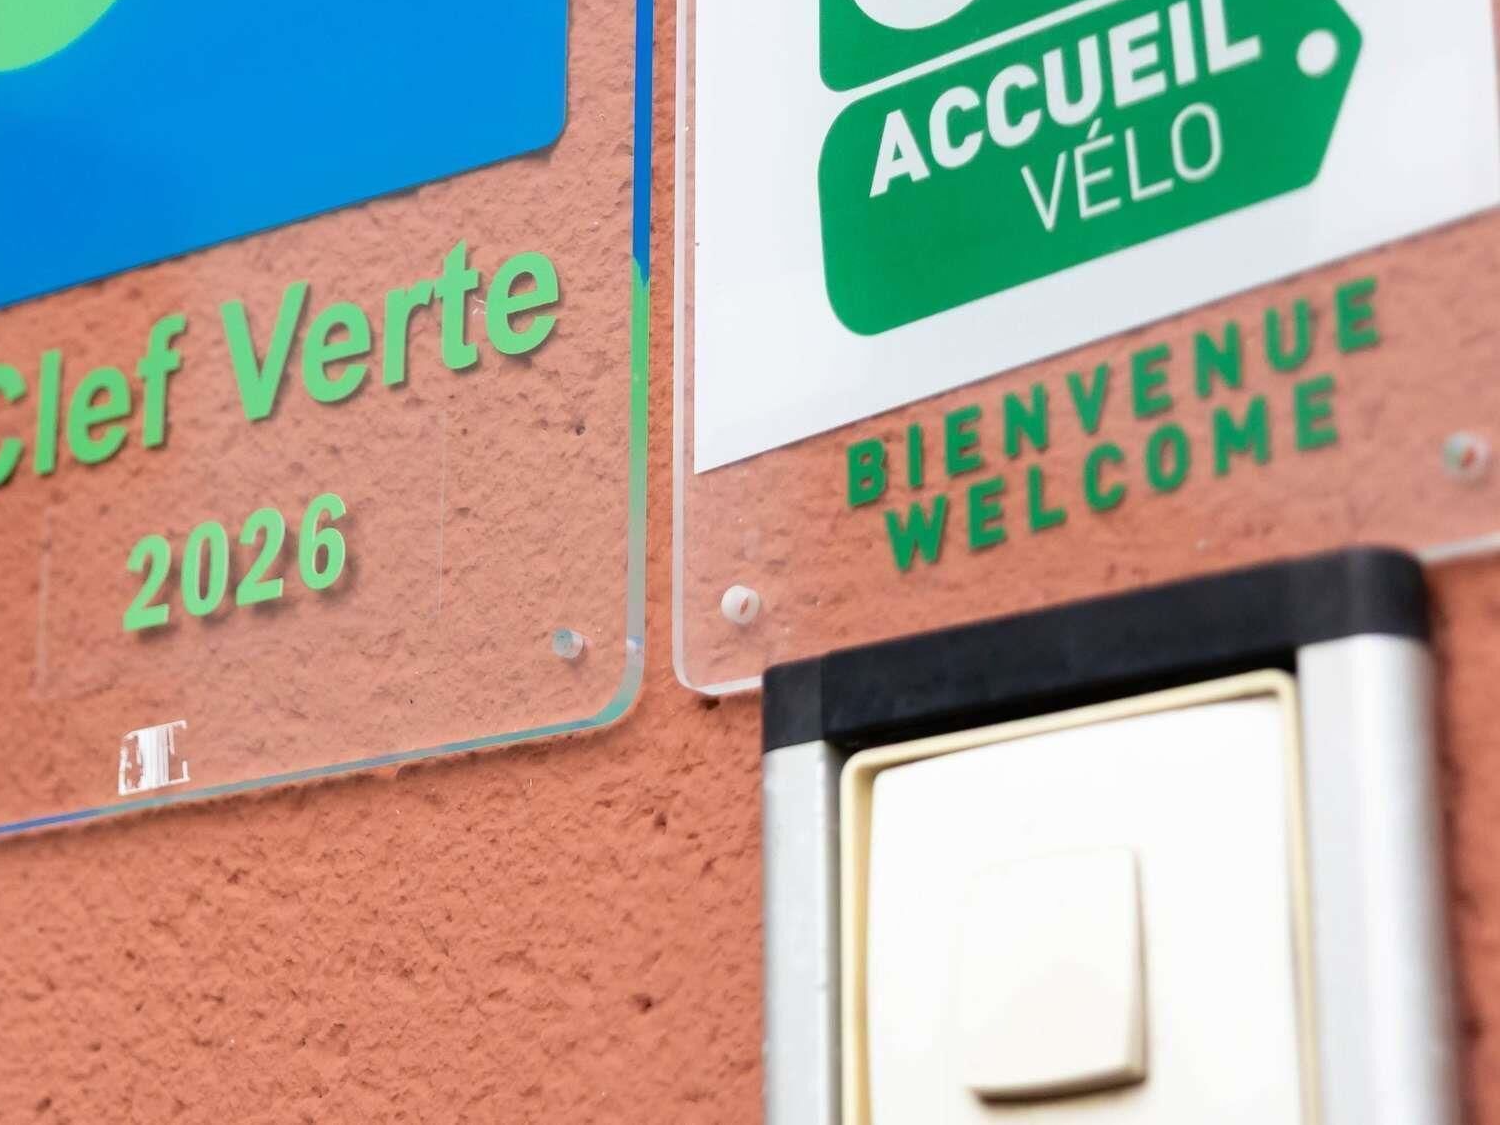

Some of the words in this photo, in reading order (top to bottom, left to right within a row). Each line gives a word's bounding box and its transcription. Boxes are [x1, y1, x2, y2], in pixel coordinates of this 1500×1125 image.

[1021, 102, 1223, 232] VÉLO
[219, 239, 560, 422] Verte
[845, 277, 1380, 507] BIENVENUE
[123, 492, 348, 633] 2026
[885, 375, 1340, 573] WELCOME
